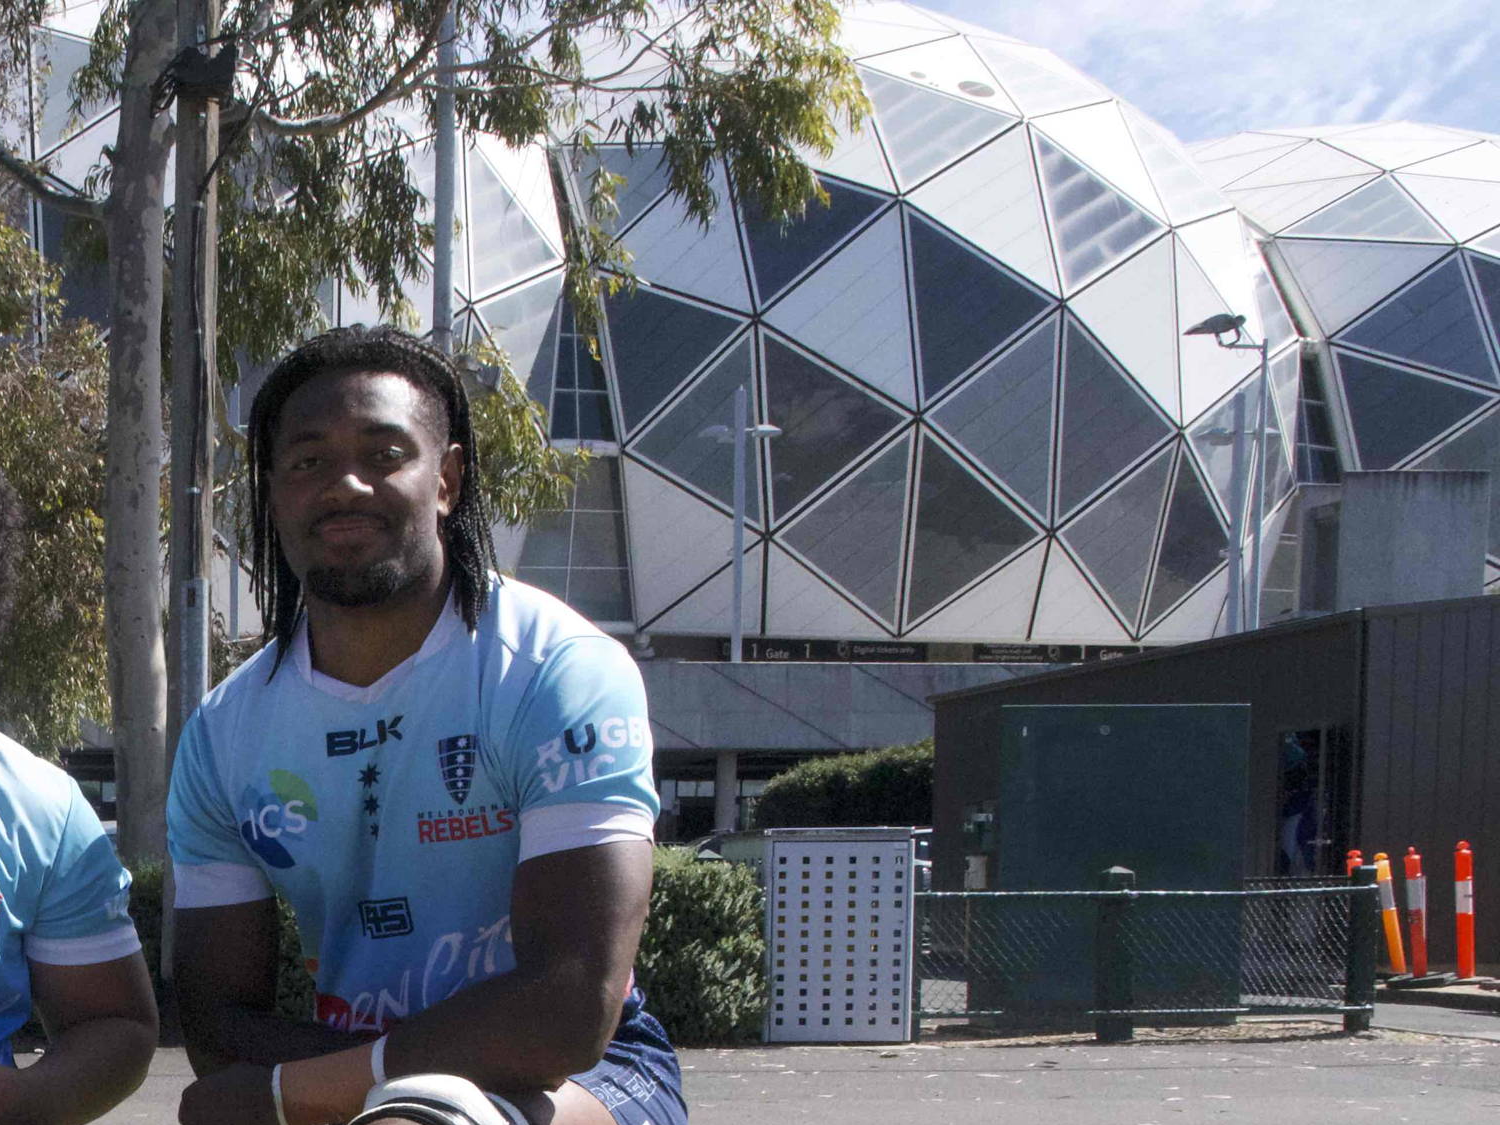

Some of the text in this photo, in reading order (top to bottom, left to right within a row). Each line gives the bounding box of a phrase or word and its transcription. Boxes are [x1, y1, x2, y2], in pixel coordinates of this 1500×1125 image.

[326, 716, 405, 757] BLK
[536, 716, 644, 768] RUGB
[248, 799, 307, 841] ICS
[418, 809, 515, 844] REBELS
